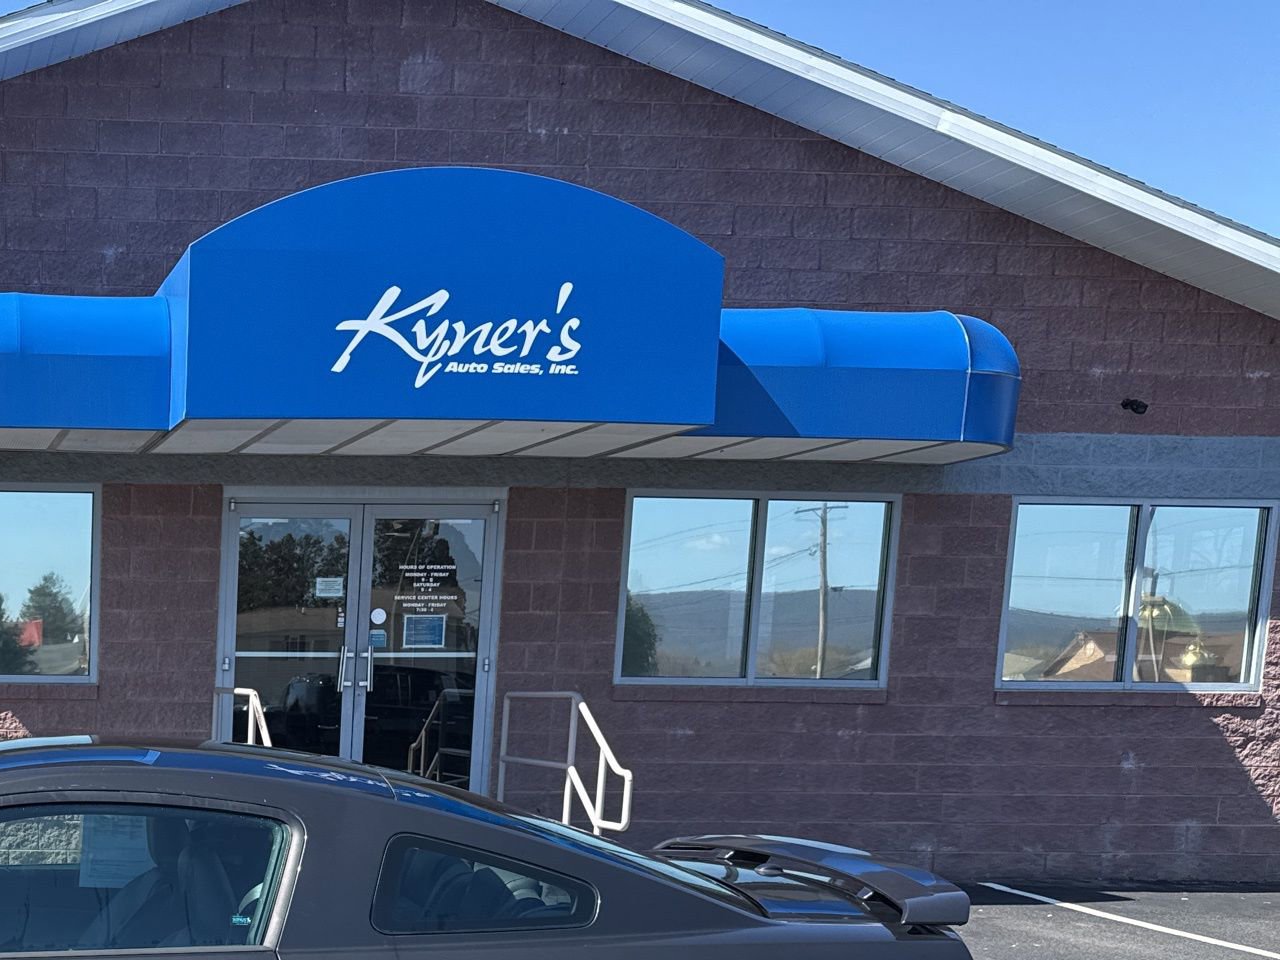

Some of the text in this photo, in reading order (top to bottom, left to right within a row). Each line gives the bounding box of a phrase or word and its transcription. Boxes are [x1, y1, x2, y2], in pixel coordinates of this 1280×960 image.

[331, 281, 582, 389] Kyner's
[444, 361, 579, 376] Auto Sales, Inc.
